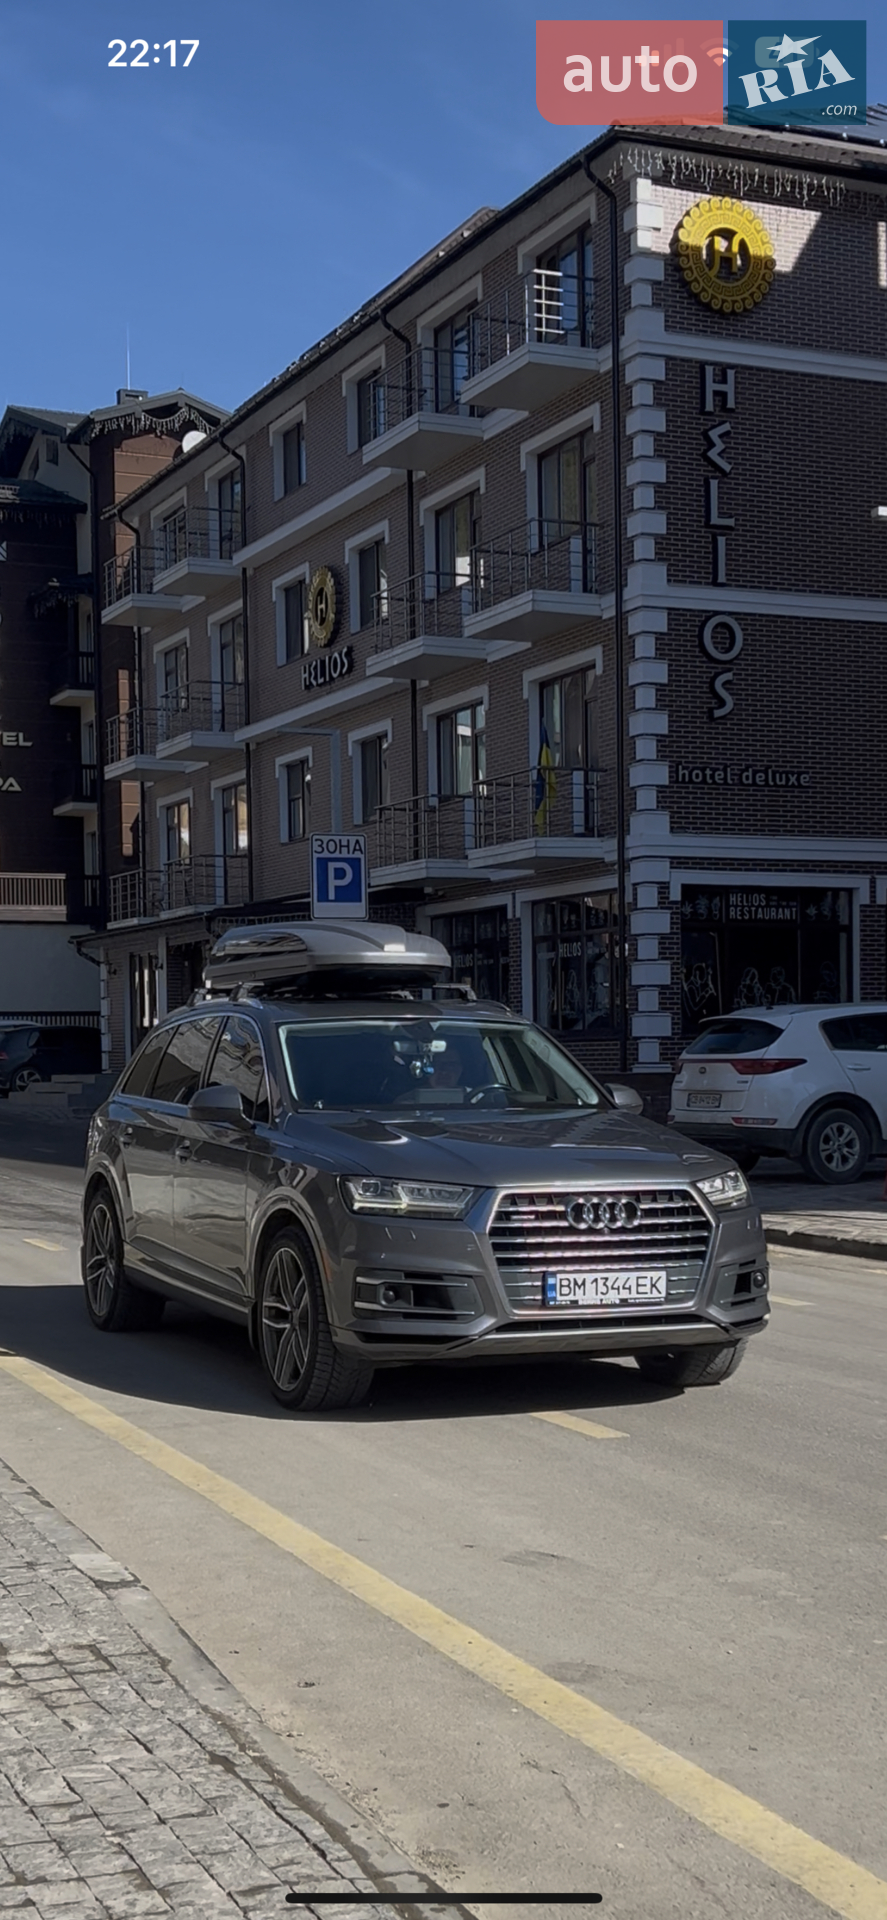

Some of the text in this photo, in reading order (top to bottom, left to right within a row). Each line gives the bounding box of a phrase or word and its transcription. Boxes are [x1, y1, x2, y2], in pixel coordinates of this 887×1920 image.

[704, 364, 744, 719] HELIOS
[301, 645, 349, 691] HELIOS
[0, 731, 33, 747] EL
[678, 764, 810, 787] hotel deluxe
[314, 838, 364, 855] ЗОНА
[327, 861, 353, 900] P
[729, 892, 766, 907] HELIOS
[729, 906, 797, 920] RESTAURANT
[559, 941, 582, 958] HELIOS
[559, 1275, 662, 1297] BM 1344 EK
